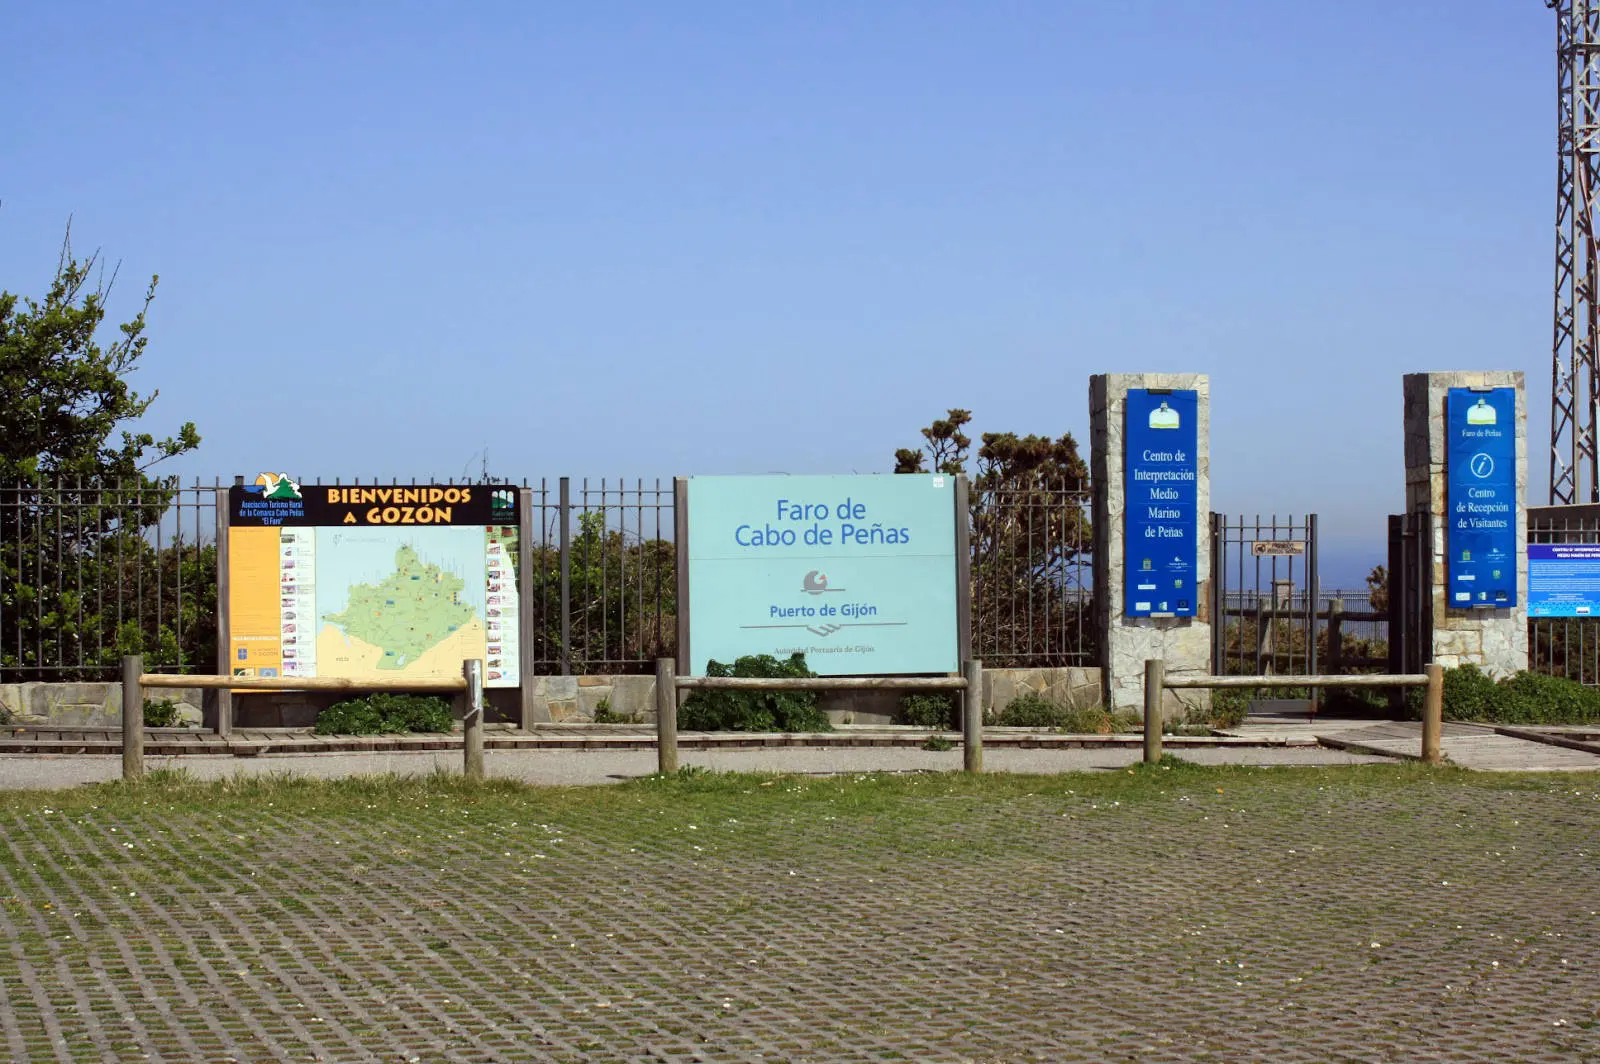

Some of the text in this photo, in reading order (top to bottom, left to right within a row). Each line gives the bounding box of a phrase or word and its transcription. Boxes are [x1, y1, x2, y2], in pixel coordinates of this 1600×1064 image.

[1461, 429, 1476, 437] Faro
[1476, 429, 1484, 437] de
[1143, 450, 1186, 462] Centro de
[1134, 468, 1194, 483] Interpretación
[327, 488, 471, 504] BIENVENIDOS
[1150, 488, 1178, 500] Medio
[1468, 488, 1495, 498] Centro
[343, 504, 452, 523] A GOZÓN
[777, 497, 866, 520] Faro de
[1148, 506, 1180, 519] Marino
[1456, 502, 1509, 514] de Recepción
[1458, 518, 1507, 528] de Visitantes
[735, 523, 910, 546] Cabo de Peñas
[1145, 526, 1184, 538] de Peñas
[770, 602, 877, 619] Puerto de Gijón
